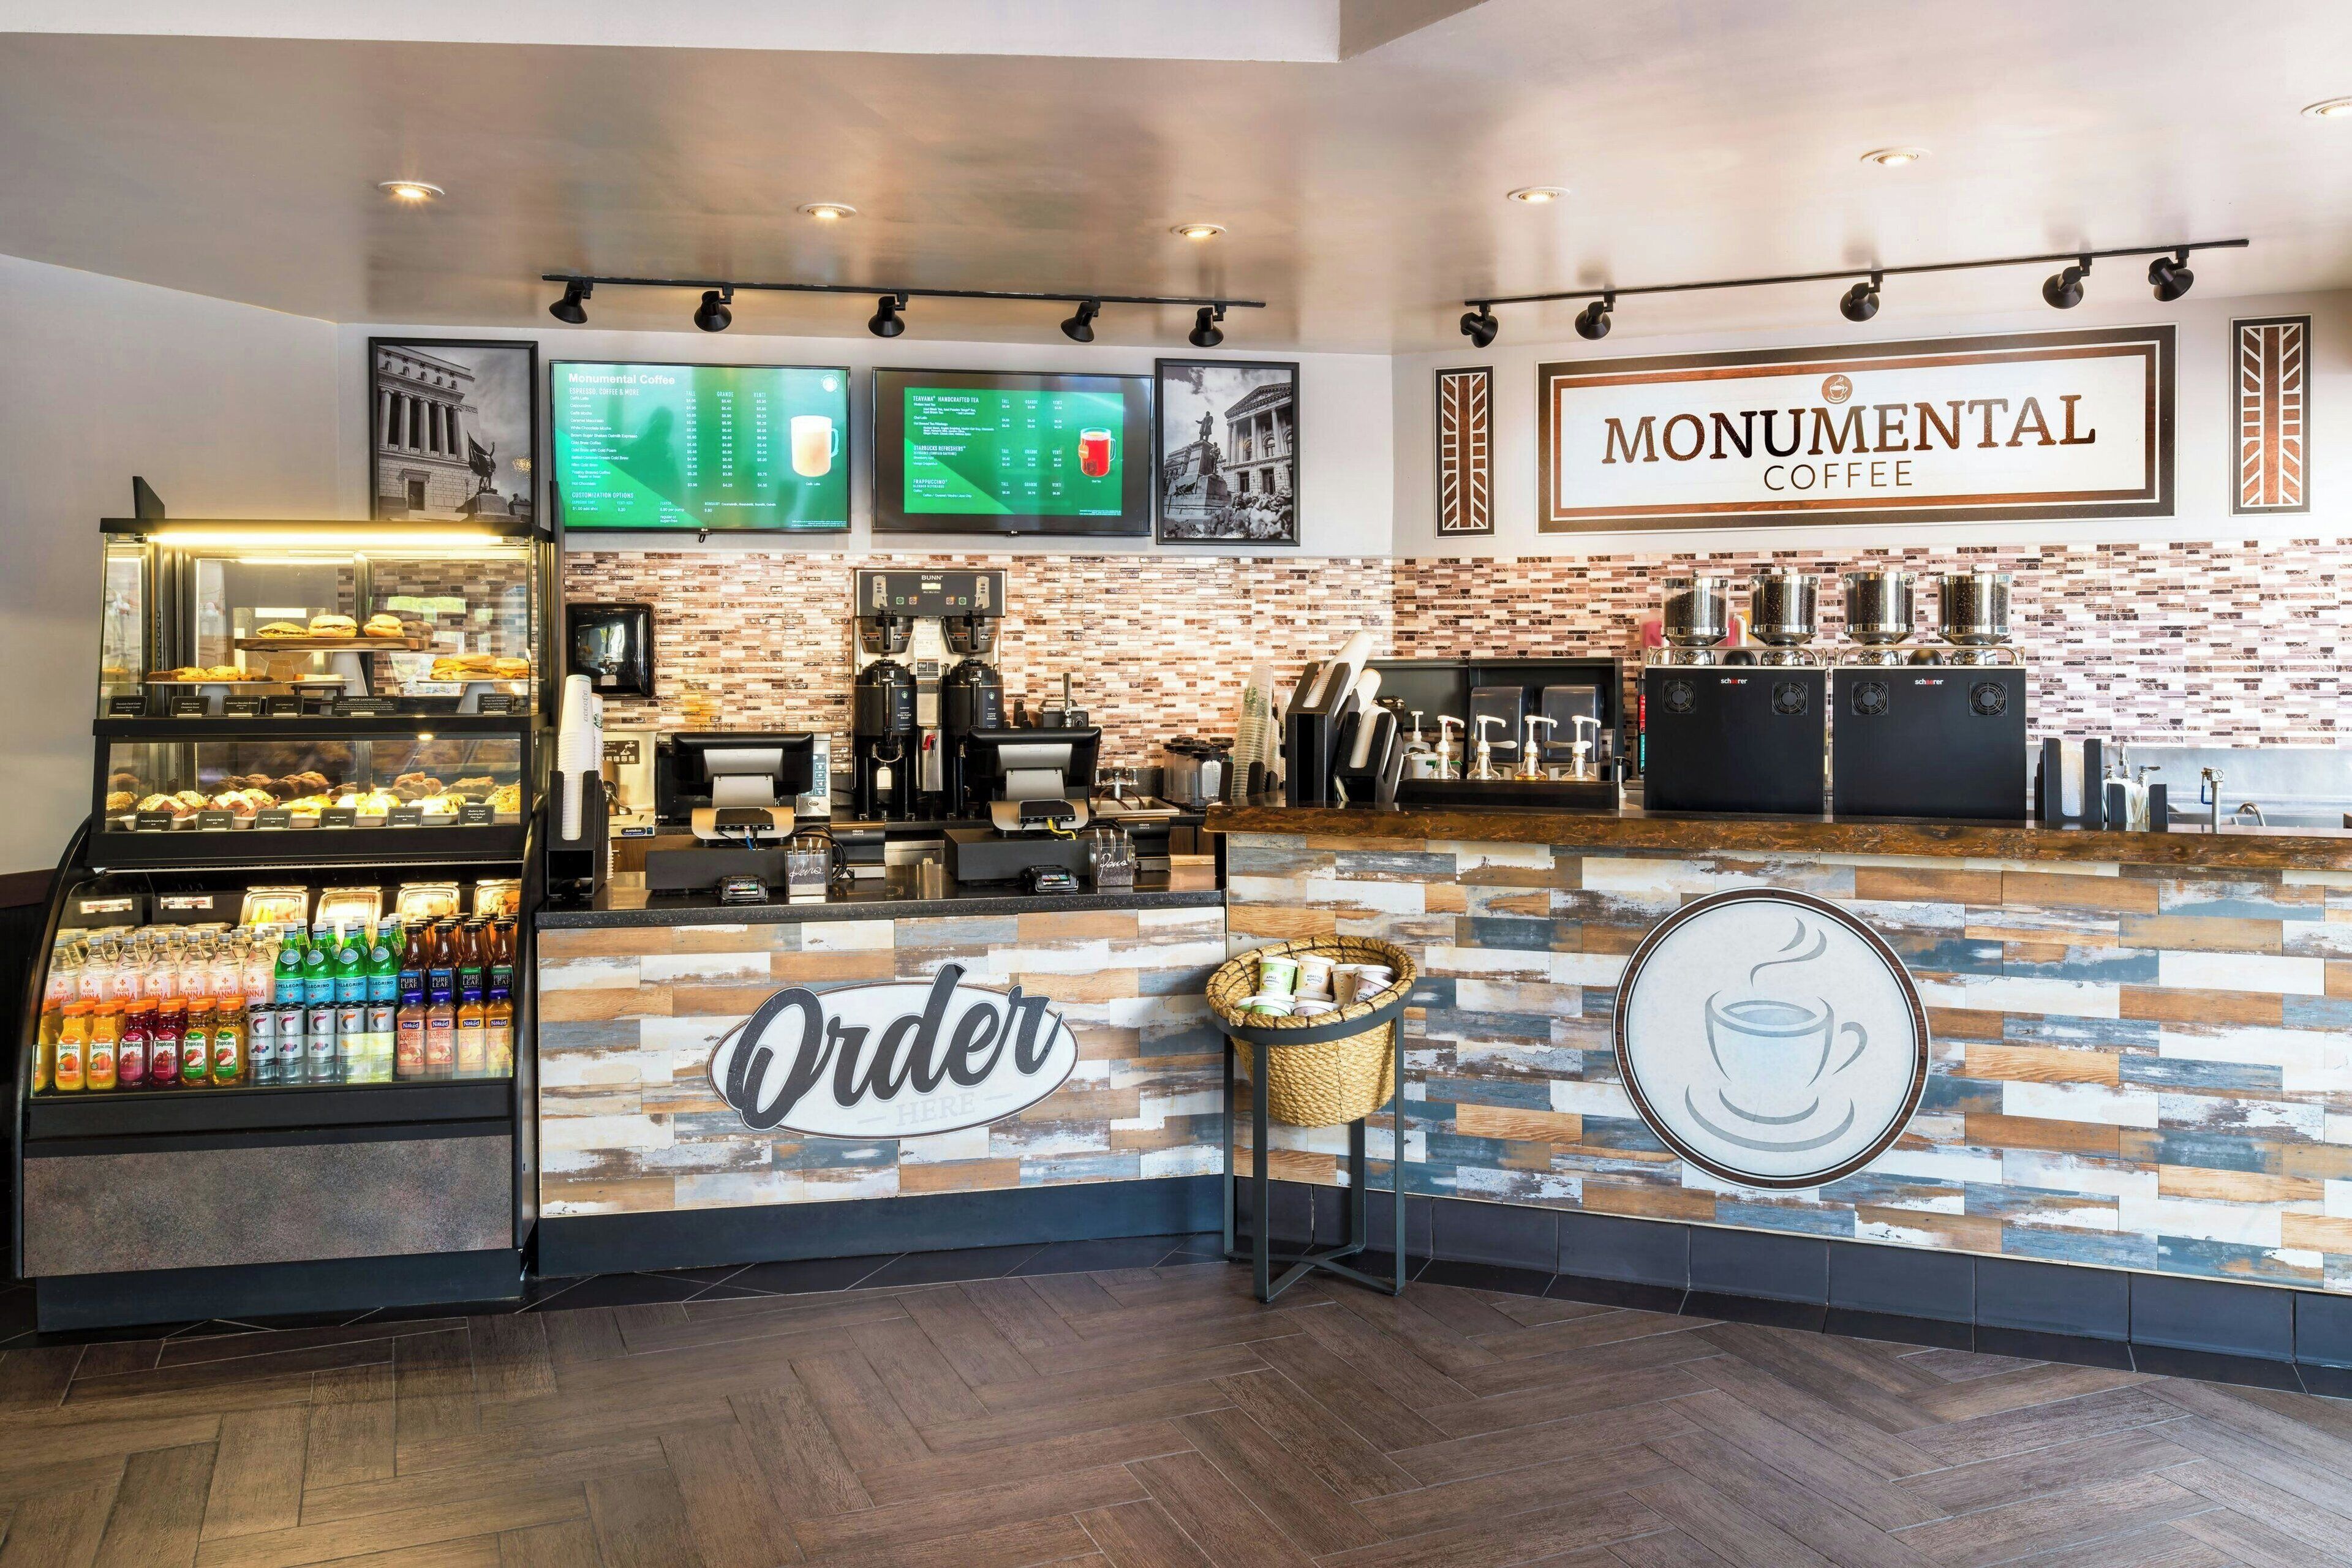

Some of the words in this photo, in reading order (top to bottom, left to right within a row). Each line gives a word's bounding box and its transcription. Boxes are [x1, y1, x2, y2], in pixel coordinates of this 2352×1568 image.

[569, 373, 636, 384] Monumental
[640, 374, 676, 385] Coffee
[570, 387, 598, 396] ESPRESSO,
[1601, 394, 2096, 465] MONUMENTAL
[1763, 459, 1912, 491] COFFEE
[726, 963, 1063, 1131] Order
[897, 1091, 975, 1126] HERE
